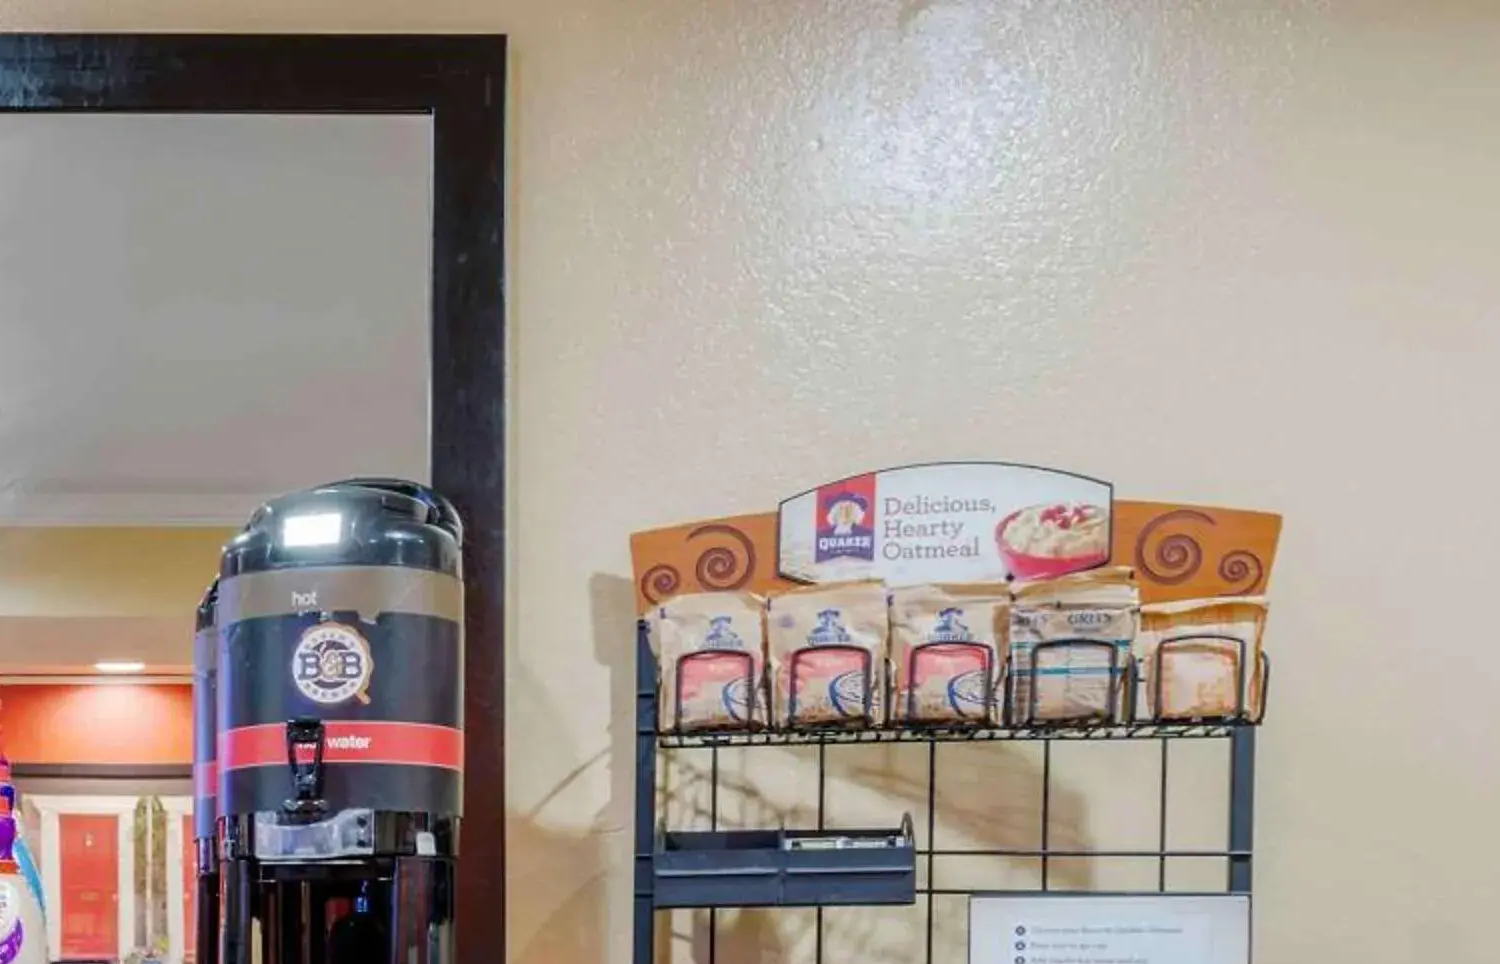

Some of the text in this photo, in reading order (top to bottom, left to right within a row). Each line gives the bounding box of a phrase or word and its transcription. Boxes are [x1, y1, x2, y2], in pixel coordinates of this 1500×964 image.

[884, 494, 996, 516] Delicious,
[884, 519, 964, 540] Hearty
[818, 535, 872, 551] QUAKER
[882, 537, 980, 561] Oatmeal
[291, 591, 318, 606] hot
[326, 735, 372, 749] water
